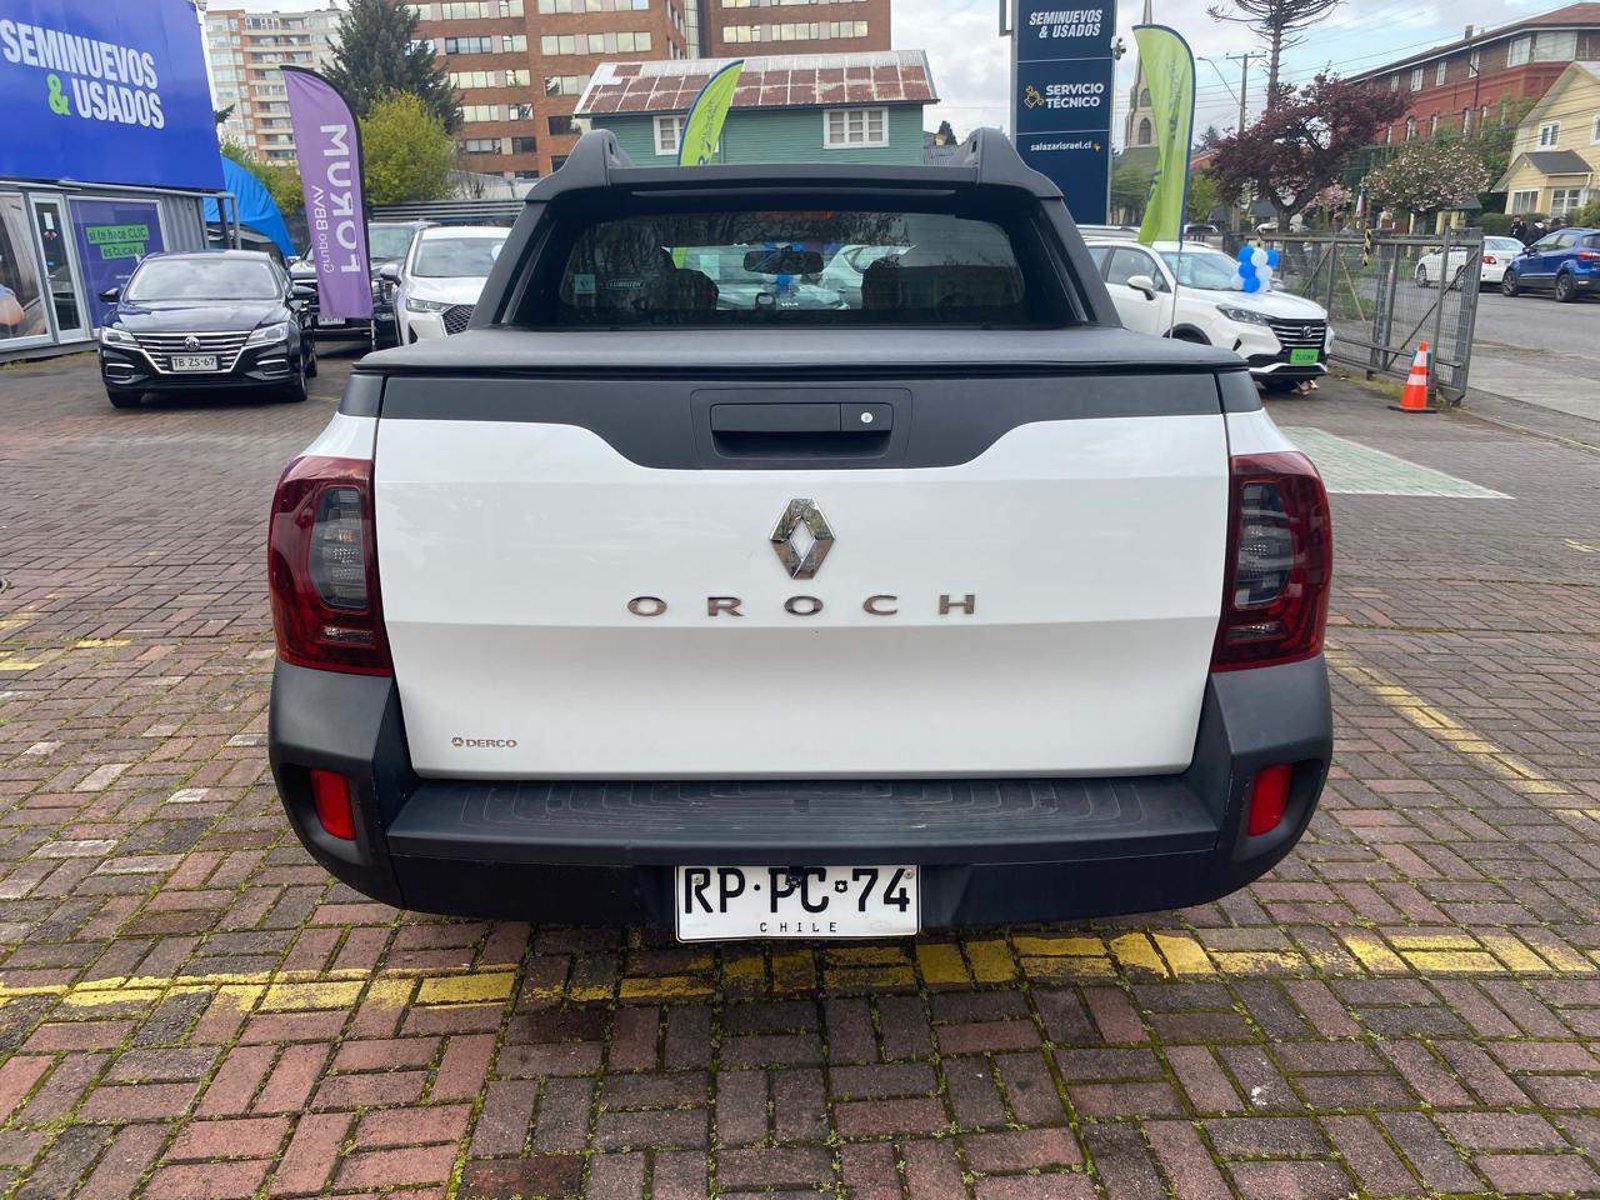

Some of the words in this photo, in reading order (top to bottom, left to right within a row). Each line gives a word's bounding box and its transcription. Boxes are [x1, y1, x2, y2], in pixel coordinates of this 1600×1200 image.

[1029, 9, 1103, 26] SEMINUEVOS
[1038, 25, 1048, 39] &
[1052, 23, 1101, 38] USADOS
[0, 19, 158, 90] SEMINUEVOS
[1045, 83, 1104, 96] SERVICIO
[46, 73, 71, 116] &
[71, 78, 165, 129] USADOS
[1045, 96, 1101, 109] TÉCNICO
[1030, 141, 1092, 152] salazarisrael.cl
[627, 594, 976, 617] OROCH
[465, 739, 517, 748] DERCO
[759, 922, 837, 933] CHILE
